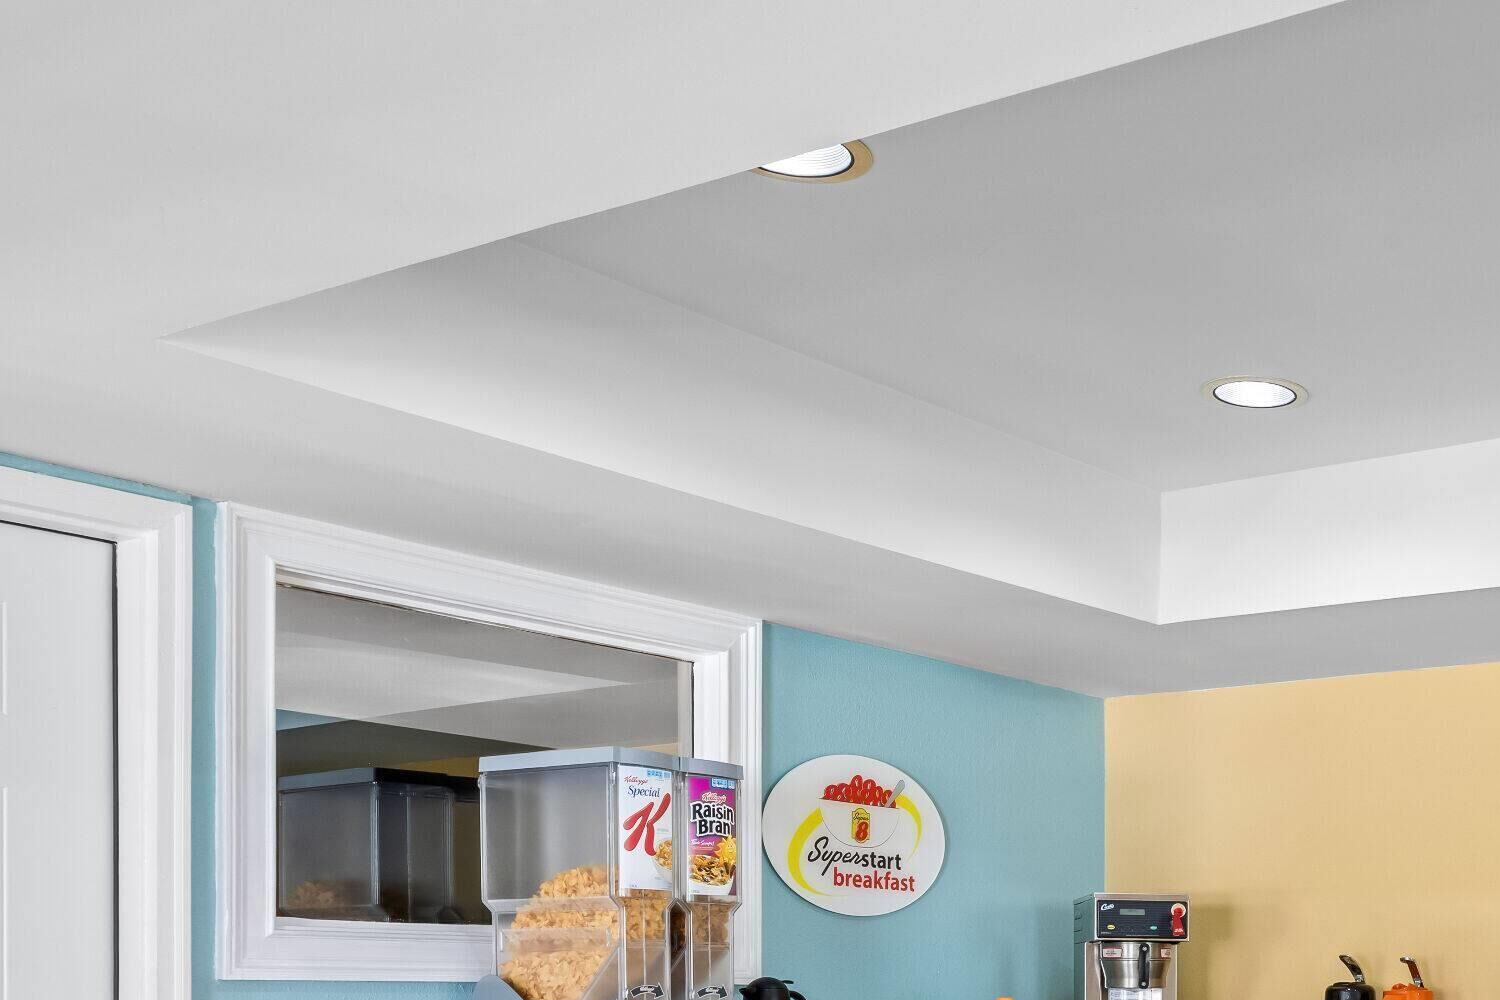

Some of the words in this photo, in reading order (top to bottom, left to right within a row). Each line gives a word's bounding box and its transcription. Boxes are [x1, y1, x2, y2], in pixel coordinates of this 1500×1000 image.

[627, 785, 660, 798] Special
[690, 802, 734, 824] Raisin
[623, 792, 671, 856] K
[697, 818, 731, 837] Bran
[855, 821, 868, 841] 8
[833, 867, 916, 892] breakfast
